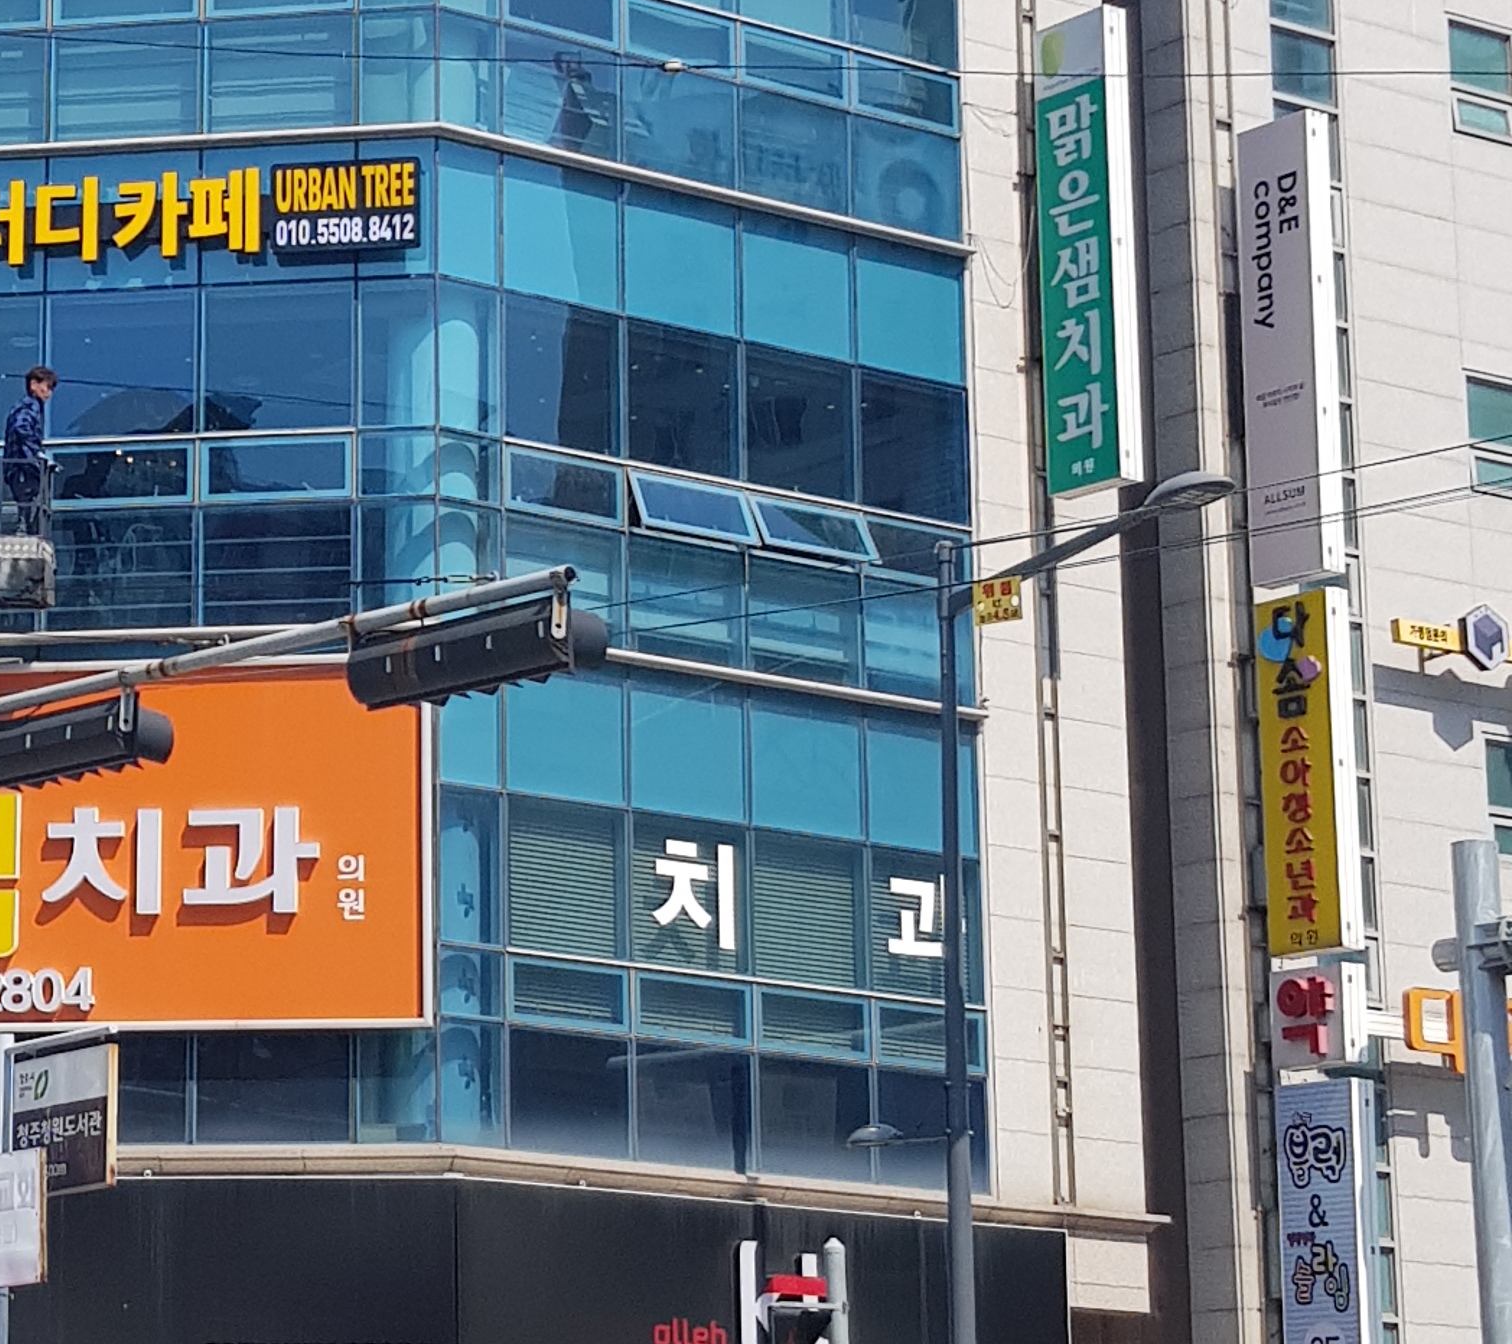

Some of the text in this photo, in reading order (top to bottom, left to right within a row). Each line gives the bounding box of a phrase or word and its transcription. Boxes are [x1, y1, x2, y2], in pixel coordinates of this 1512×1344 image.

[276, 161, 416, 213] URBAN TREE
[1277, 169, 1300, 235] D&E
[275, 213, 415, 247] 010.5508.8412
[1252, 180, 1276, 330] company
[1044, 94, 1110, 450] 맑은샘치과
[1279, 725, 1319, 926] 소아청소년과
[335, 851, 368, 922] 의원
[651, 838, 736, 950] 치
[1276, 974, 1336, 1057] 약
[16, 1110, 102, 1148] 청주청원도서관
